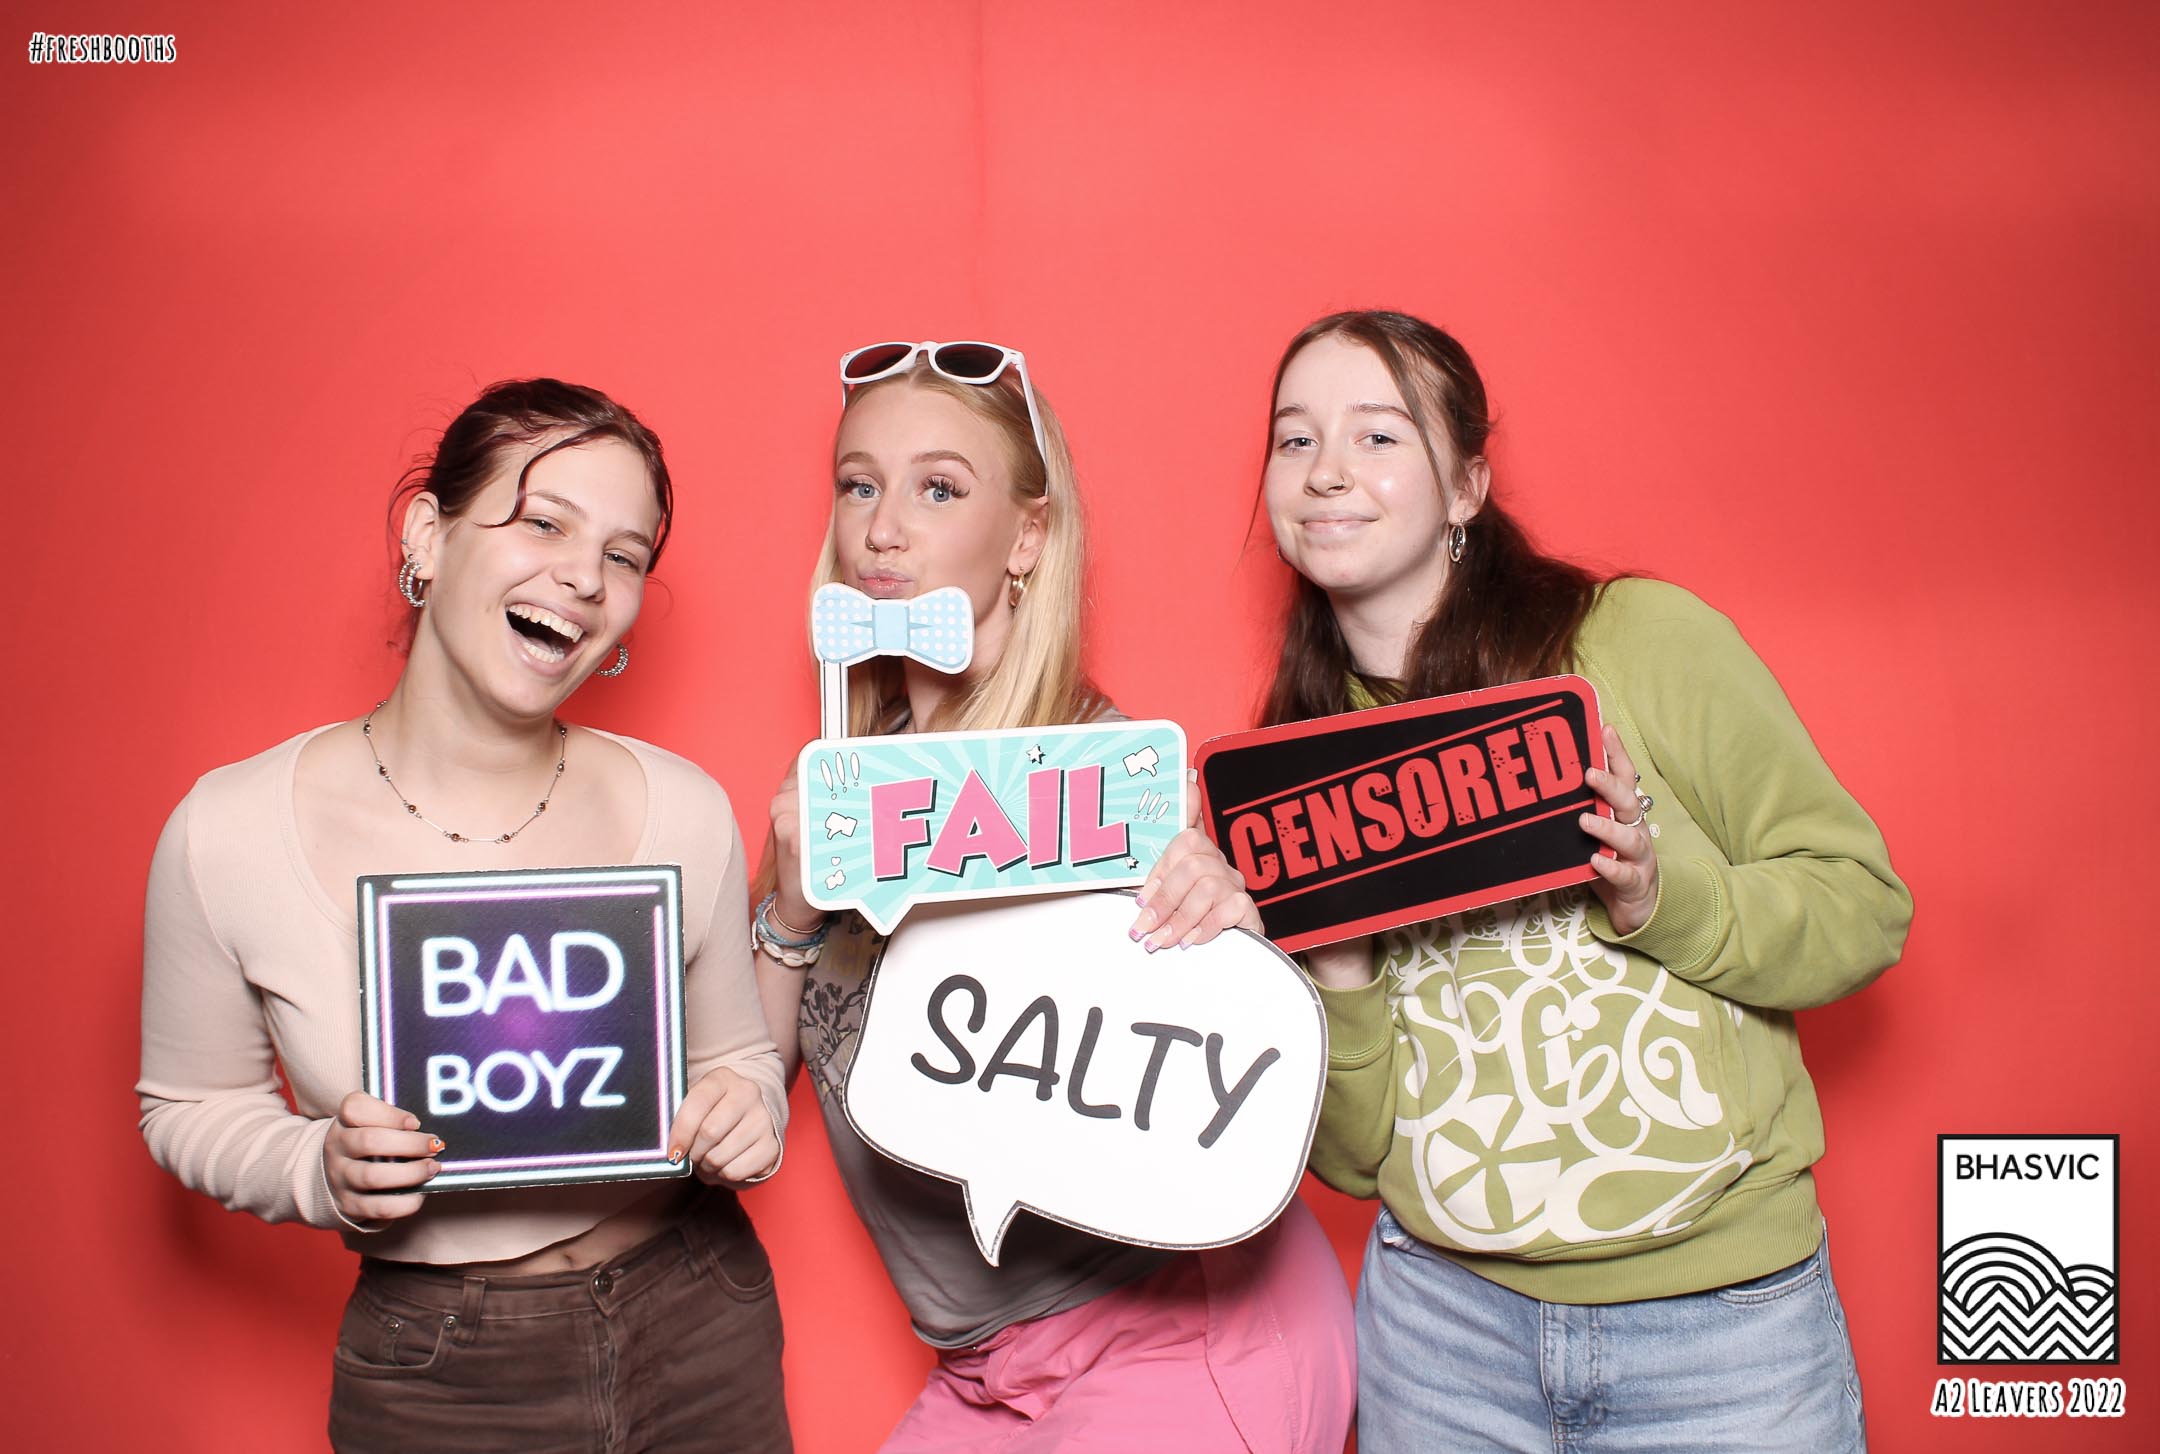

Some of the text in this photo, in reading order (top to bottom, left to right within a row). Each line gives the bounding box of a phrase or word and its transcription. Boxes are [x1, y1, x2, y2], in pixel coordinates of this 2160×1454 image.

[869, 764, 1130, 882] FAIL
[1229, 715, 1585, 891] CENSORED
[421, 931, 625, 1017] BAD
[427, 1046, 627, 1116] BOYZ
[910, 974, 1281, 1149] SALTY
